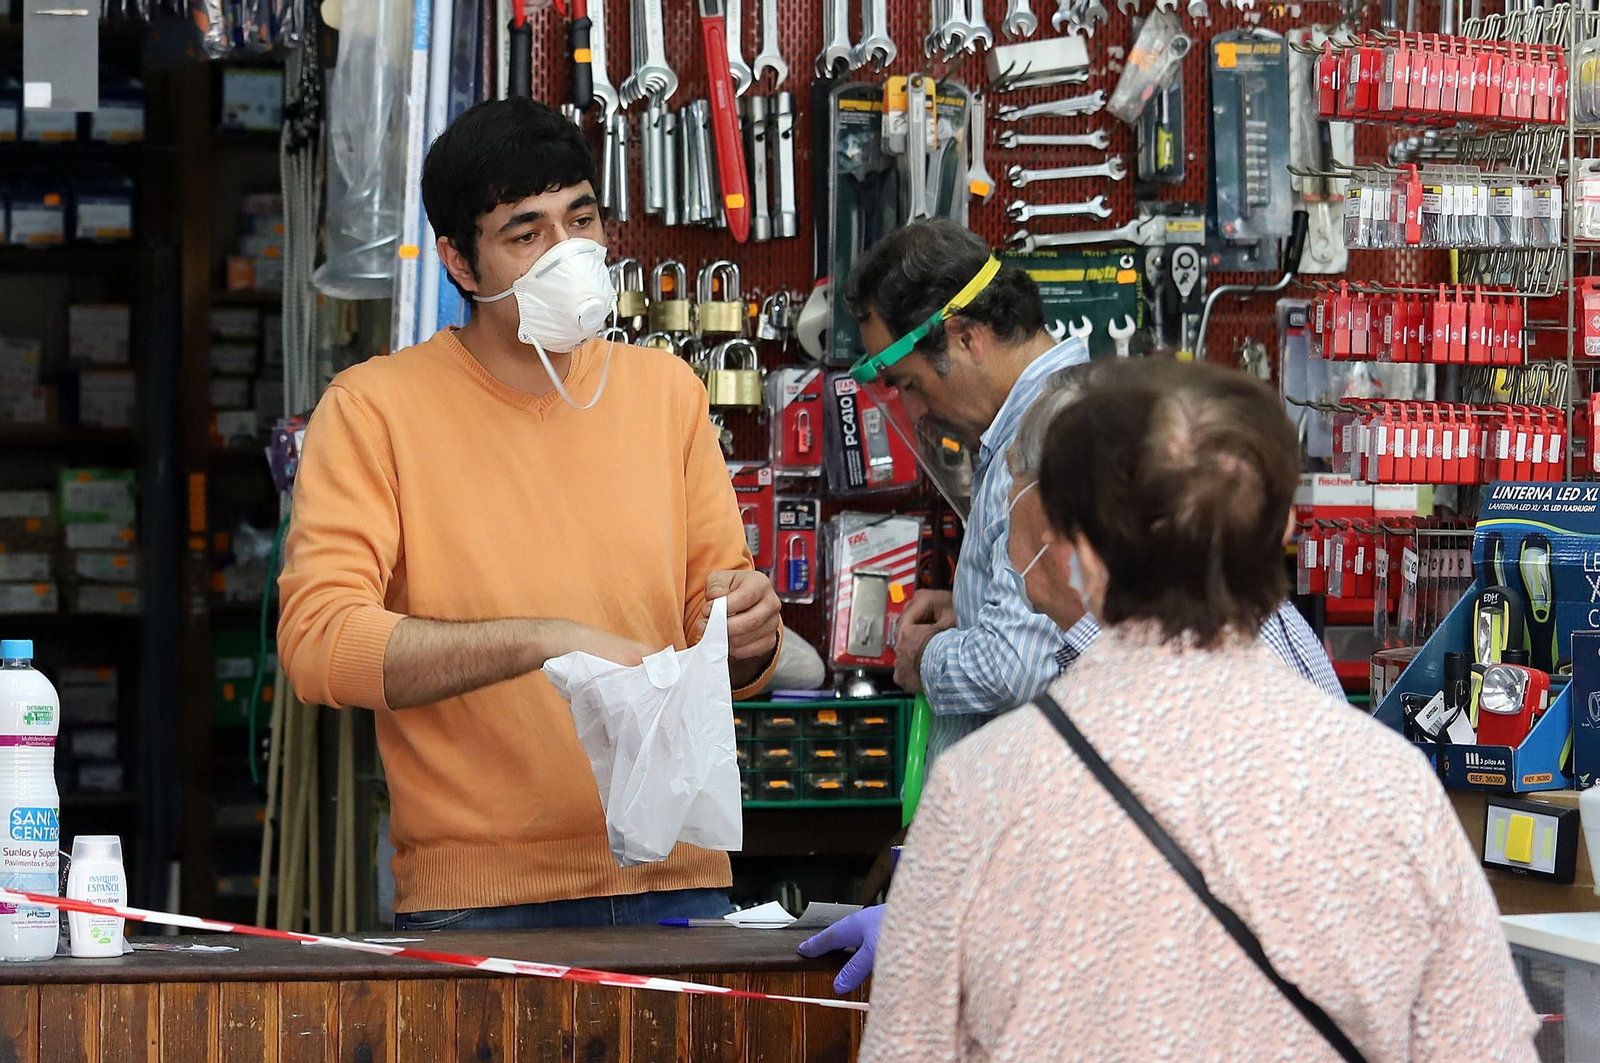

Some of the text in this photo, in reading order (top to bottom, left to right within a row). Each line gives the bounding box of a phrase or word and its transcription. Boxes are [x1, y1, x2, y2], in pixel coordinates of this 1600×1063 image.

[840, 396, 858, 446] PC410
[1492, 486, 1600, 502] LINTERNA LED XL
[1488, 502, 1519, 511] LANTERNA
[1519, 503, 1532, 512] LED
[1551, 504, 1562, 512] LED
[1562, 504, 1597, 513] FLASHLIGHT
[1483, 593, 1499, 603] EDM
[1470, 774, 1484, 783] REF.
[12, 810, 51, 826] SANI
[11, 826, 59, 840] CENTRO
[3, 847, 31, 857] Suelos
[32, 850, 38, 859] y
[4, 859, 41, 867] Pavimentos
[89, 874, 119, 885] INSTITUTO
[87, 883, 120, 892] ESPAÑOL
[26, 910, 37, 918] pH
